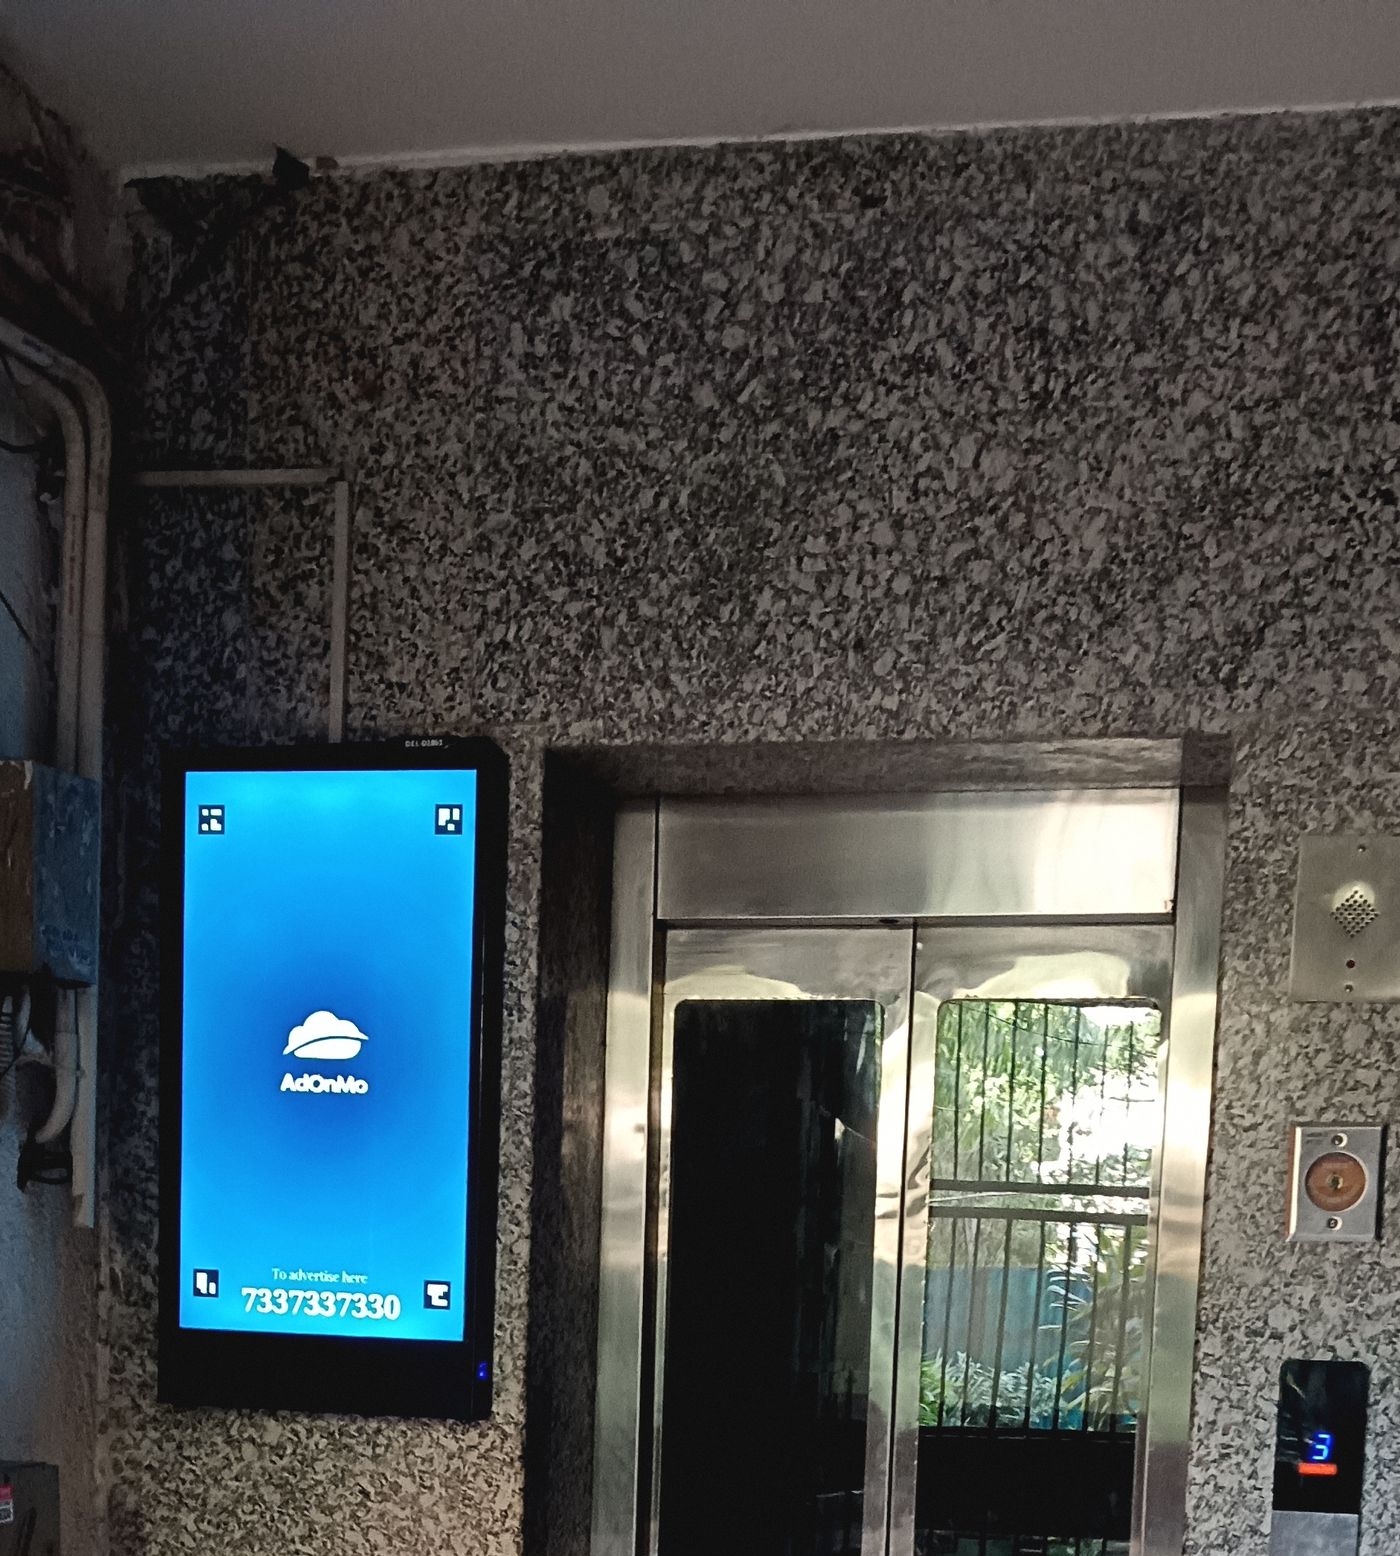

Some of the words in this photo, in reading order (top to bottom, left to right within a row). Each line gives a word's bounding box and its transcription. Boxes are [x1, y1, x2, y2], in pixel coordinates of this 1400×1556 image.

[280, 1072, 369, 1095] AdOnMo
[272, 1268, 287, 1281] To
[289, 1268, 340, 1283] advertise
[342, 1270, 368, 1284] here
[241, 1286, 401, 1321] 7337337330
[1311, 1433, 1331, 1460] 3
